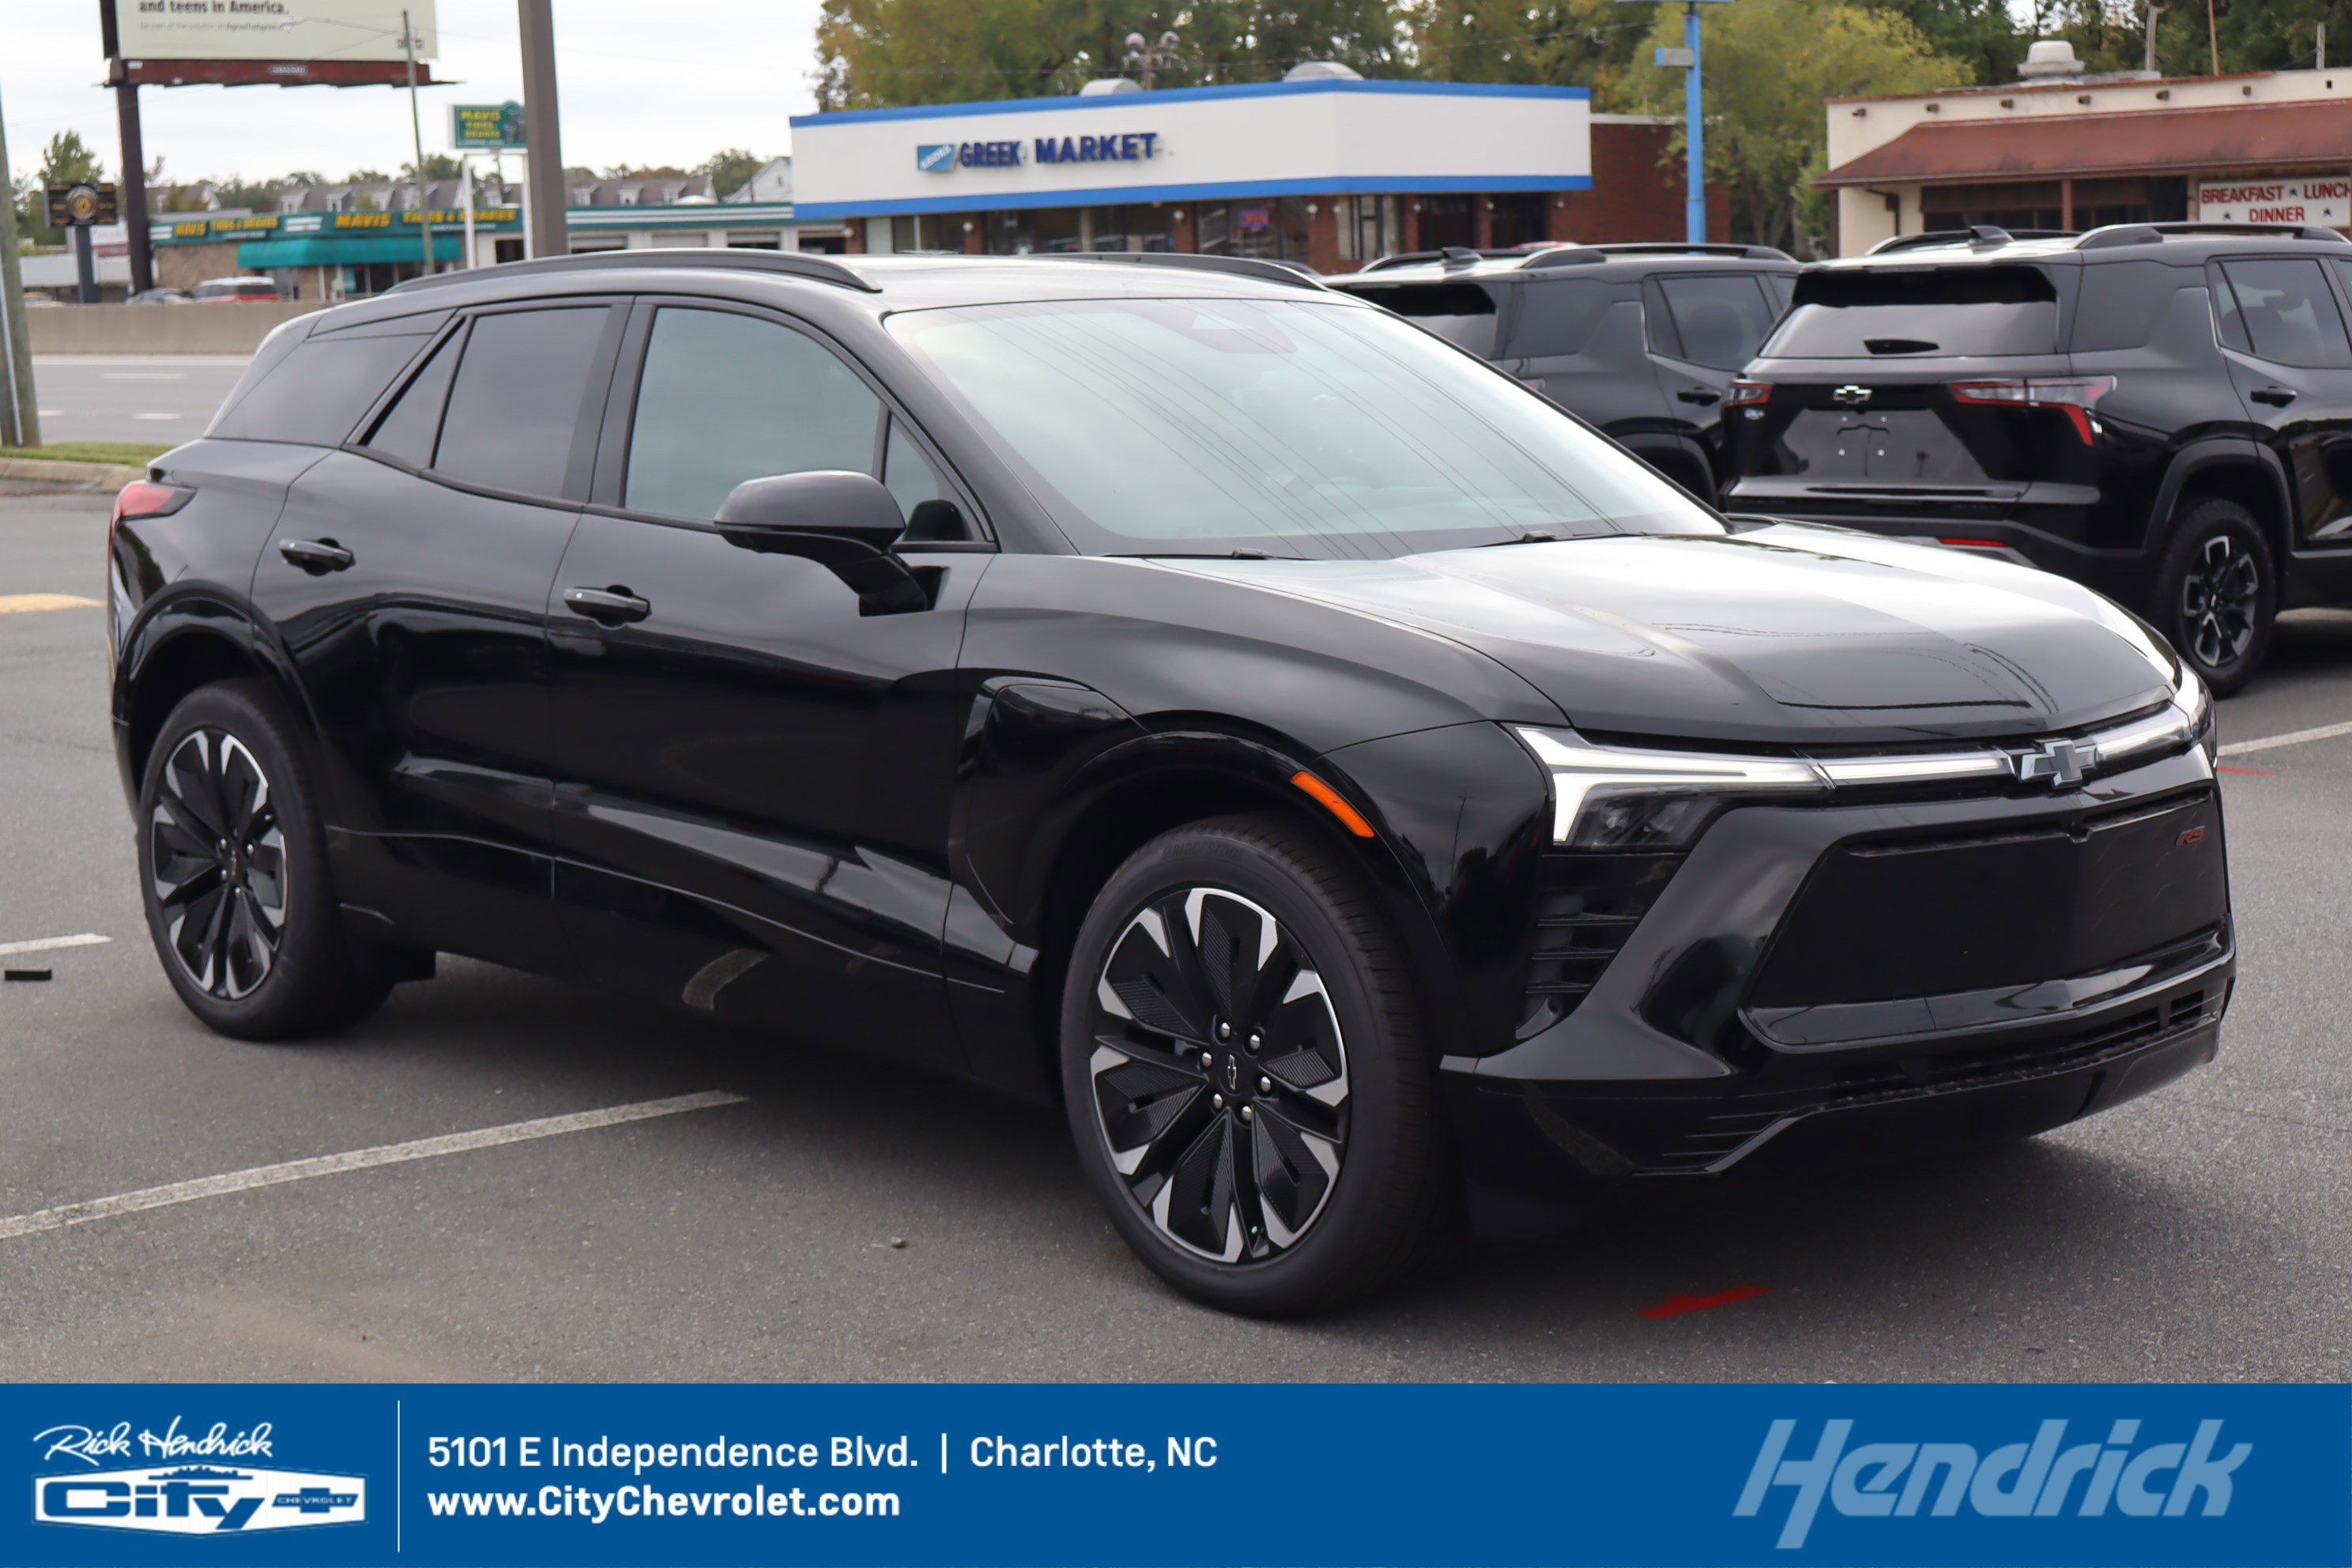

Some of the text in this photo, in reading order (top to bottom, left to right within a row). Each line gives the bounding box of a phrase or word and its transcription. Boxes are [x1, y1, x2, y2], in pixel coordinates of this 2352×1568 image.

[139, 0, 289, 13] and teens in America.
[959, 133, 1158, 168] GREEK MARKET
[2201, 185, 2284, 205] BREAKFAST
[335, 212, 392, 228] MAVIS
[458, 209, 516, 223] BAKES
[2248, 205, 2305, 223] DINNER
[175, 221, 206, 236] MAVIS
[2176, 825, 2206, 846] RS
